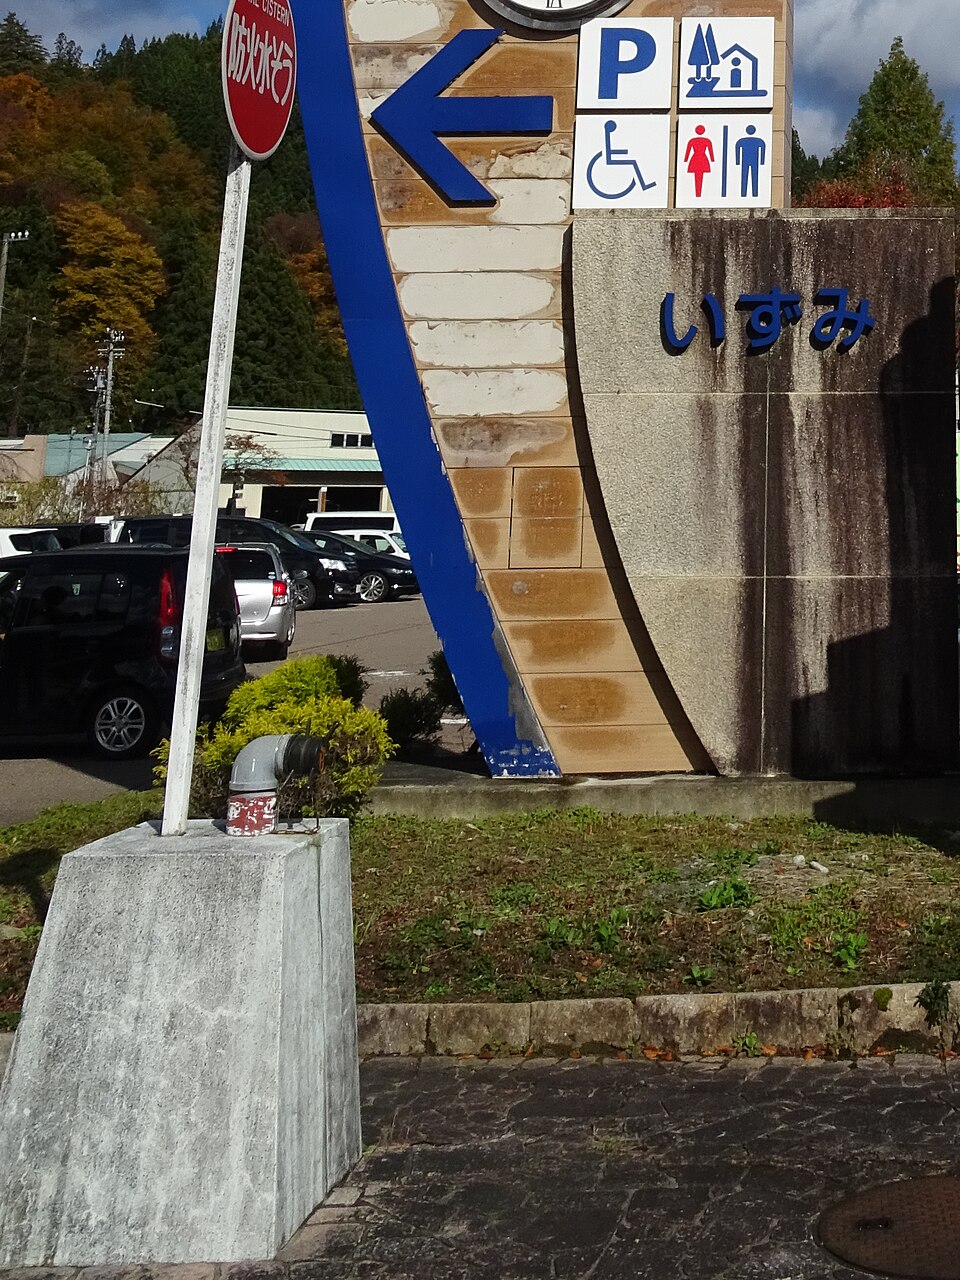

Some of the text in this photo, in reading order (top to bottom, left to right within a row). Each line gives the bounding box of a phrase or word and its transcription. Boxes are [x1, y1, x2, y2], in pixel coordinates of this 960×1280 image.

[228, 12, 294, 106] 防火水そう
[598, 27, 657, 100] P
[662, 285, 876, 352] いずみ
